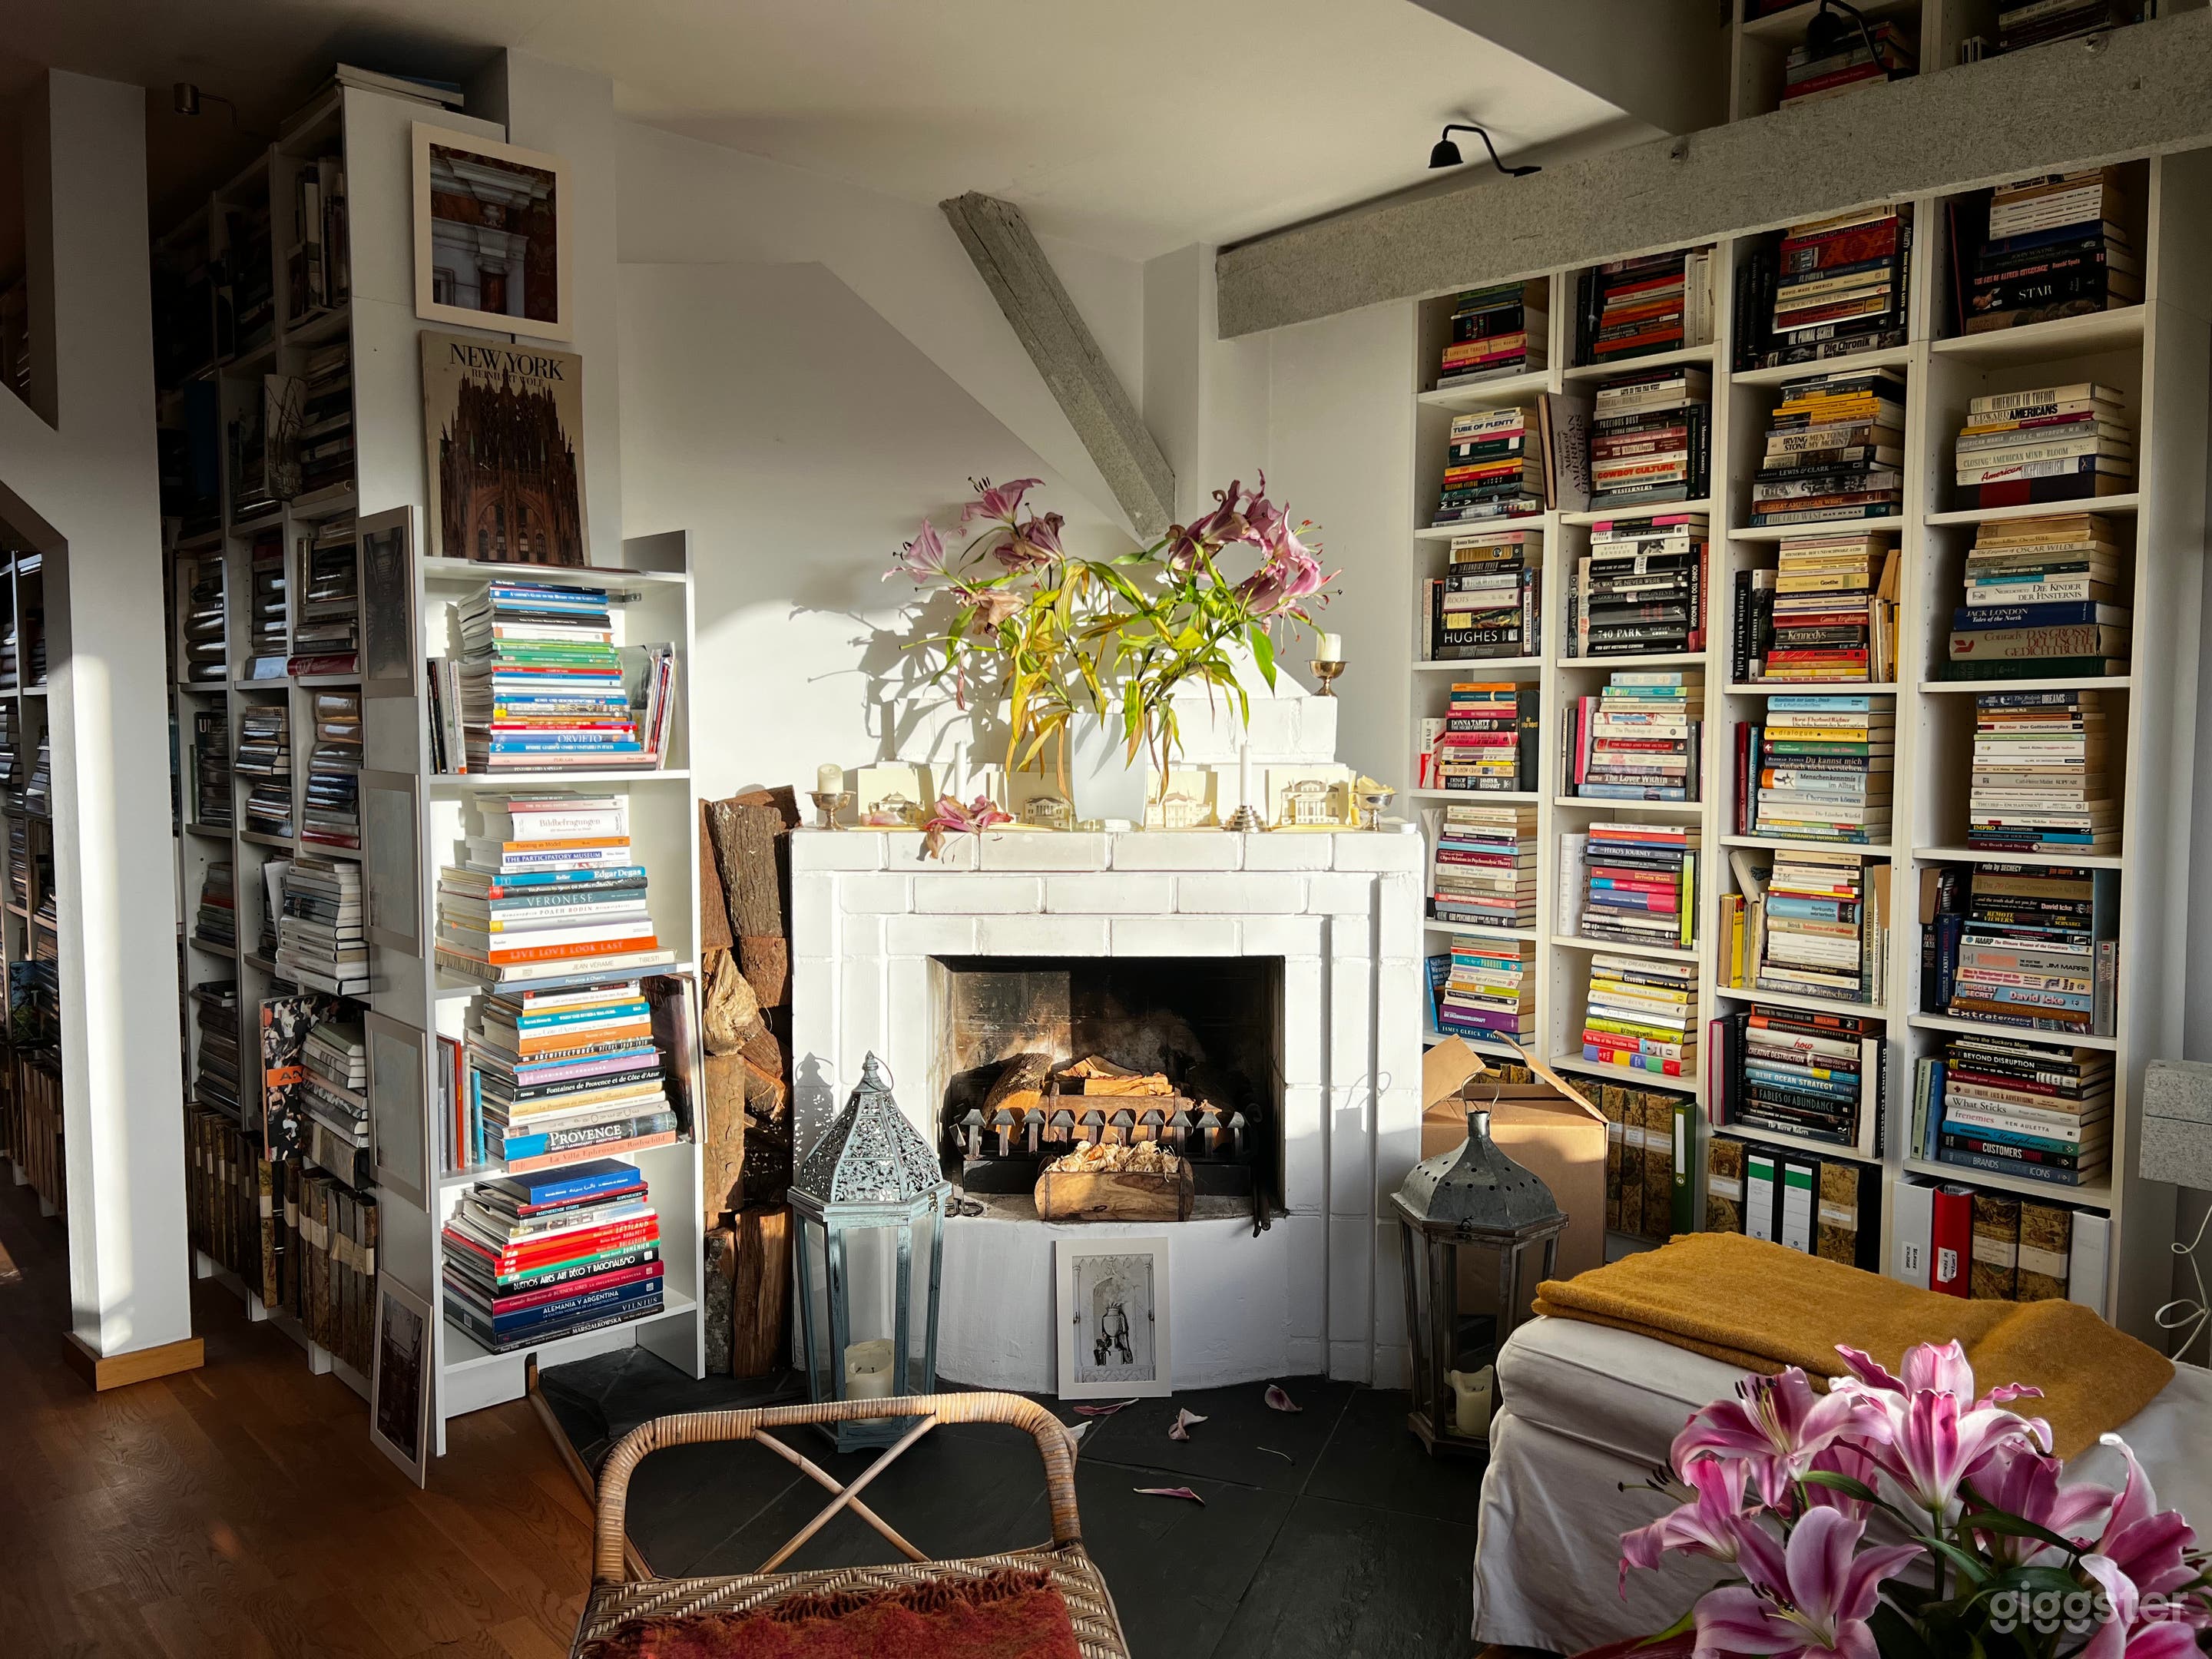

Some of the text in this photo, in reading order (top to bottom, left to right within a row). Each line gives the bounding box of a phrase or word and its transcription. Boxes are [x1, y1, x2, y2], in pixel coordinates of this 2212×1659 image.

[2018, 284, 2052, 301] STAR
[1823, 336, 1870, 353] Die Chronik
[449, 343, 565, 382] NEW YORK
[1992, 394, 2022, 410] AMERICA
[2032, 389, 2057, 405] THEORY
[2009, 404, 2058, 420] AMERICANS
[1485, 419, 1515, 429] PLENTY
[1783, 436, 1807, 445] IRVING
[1784, 442, 1807, 451] STONE
[2046, 447, 2068, 456] BLOOM
[1597, 463, 1675, 479] COWBOY CULTURE
[1980, 465, 2023, 482] American
[1611, 485, 1652, 495] WESTERNERS
[2015, 544, 2045, 554] OSCAR
[2032, 582, 2081, 593] DIE KINDER
[2018, 593, 2035, 601] DER
[1966, 608, 2029, 618] JACK LONDON
[1445, 630, 1498, 644] HUGHES
[1598, 628, 1642, 639] 740 PARK
[1787, 630, 1827, 641] Kennedys
[1736, 657, 1744, 671] fall
[2041, 692, 2065, 704] DREAMS
[1800, 773, 1856, 782] Menschenkenntnis
[1838, 782, 1856, 790] Alltag
[540, 818, 601, 826] Bildbefragungen
[522, 853, 571, 862] PARTICIPATORY
[594, 870, 617, 879] Edgar
[527, 893, 594, 907] VERONESE
[510, 941, 624, 959] LIVE LOVE LOOK LAST
[2060, 964, 2089, 972] MARRS
[1624, 975, 1646, 984] Economy
[1965, 990, 1994, 999] SECRET
[2010, 991, 2065, 1005] David Icke
[1460, 1028, 1481, 1037] GLEICK
[1621, 1027, 1653, 1037] groundswell
[1793, 1038, 1814, 1049] how
[535, 1048, 594, 1061] ARCHITECTURES
[1963, 1052, 2035, 1068] BEYOND DISRUPTION
[546, 1084, 575, 1094] Fontaines
[585, 1079, 611, 1088] Provence
[641, 1071, 661, 1079] d'Azur
[1774, 1075, 1796, 1084] OCEAN
[1799, 1078, 1833, 1090] STRATEGY
[1760, 1088, 1783, 1102] FABLES
[1783, 1094, 1791, 1103] OF
[1793, 1097, 1834, 1113] ABUNDANCE
[1952, 1097, 2007, 1114] What Sticks
[1955, 1111, 1995, 1124] frenemies
[2020, 1123, 2050, 1132] AULETTA
[550, 1125, 622, 1145] PROVENCE
[563, 1152, 580, 1161] Villa
[1982, 1143, 2022, 1159] CUSTOMERS
[1972, 1157, 2050, 1178] BRANDS ICONS
[616, 1221, 649, 1233] LETTLAND
[514, 1279, 538, 1290] BUENOS
[541, 1274, 555, 1286] AIRES
[558, 1271, 567, 1280] ART
[554, 1288, 574, 1296] BUENOS
[543, 1300, 575, 1314] ALEMANIA
[583, 1291, 618, 1304] ARGENTINA
[622, 1297, 657, 1311] VILNIUS
